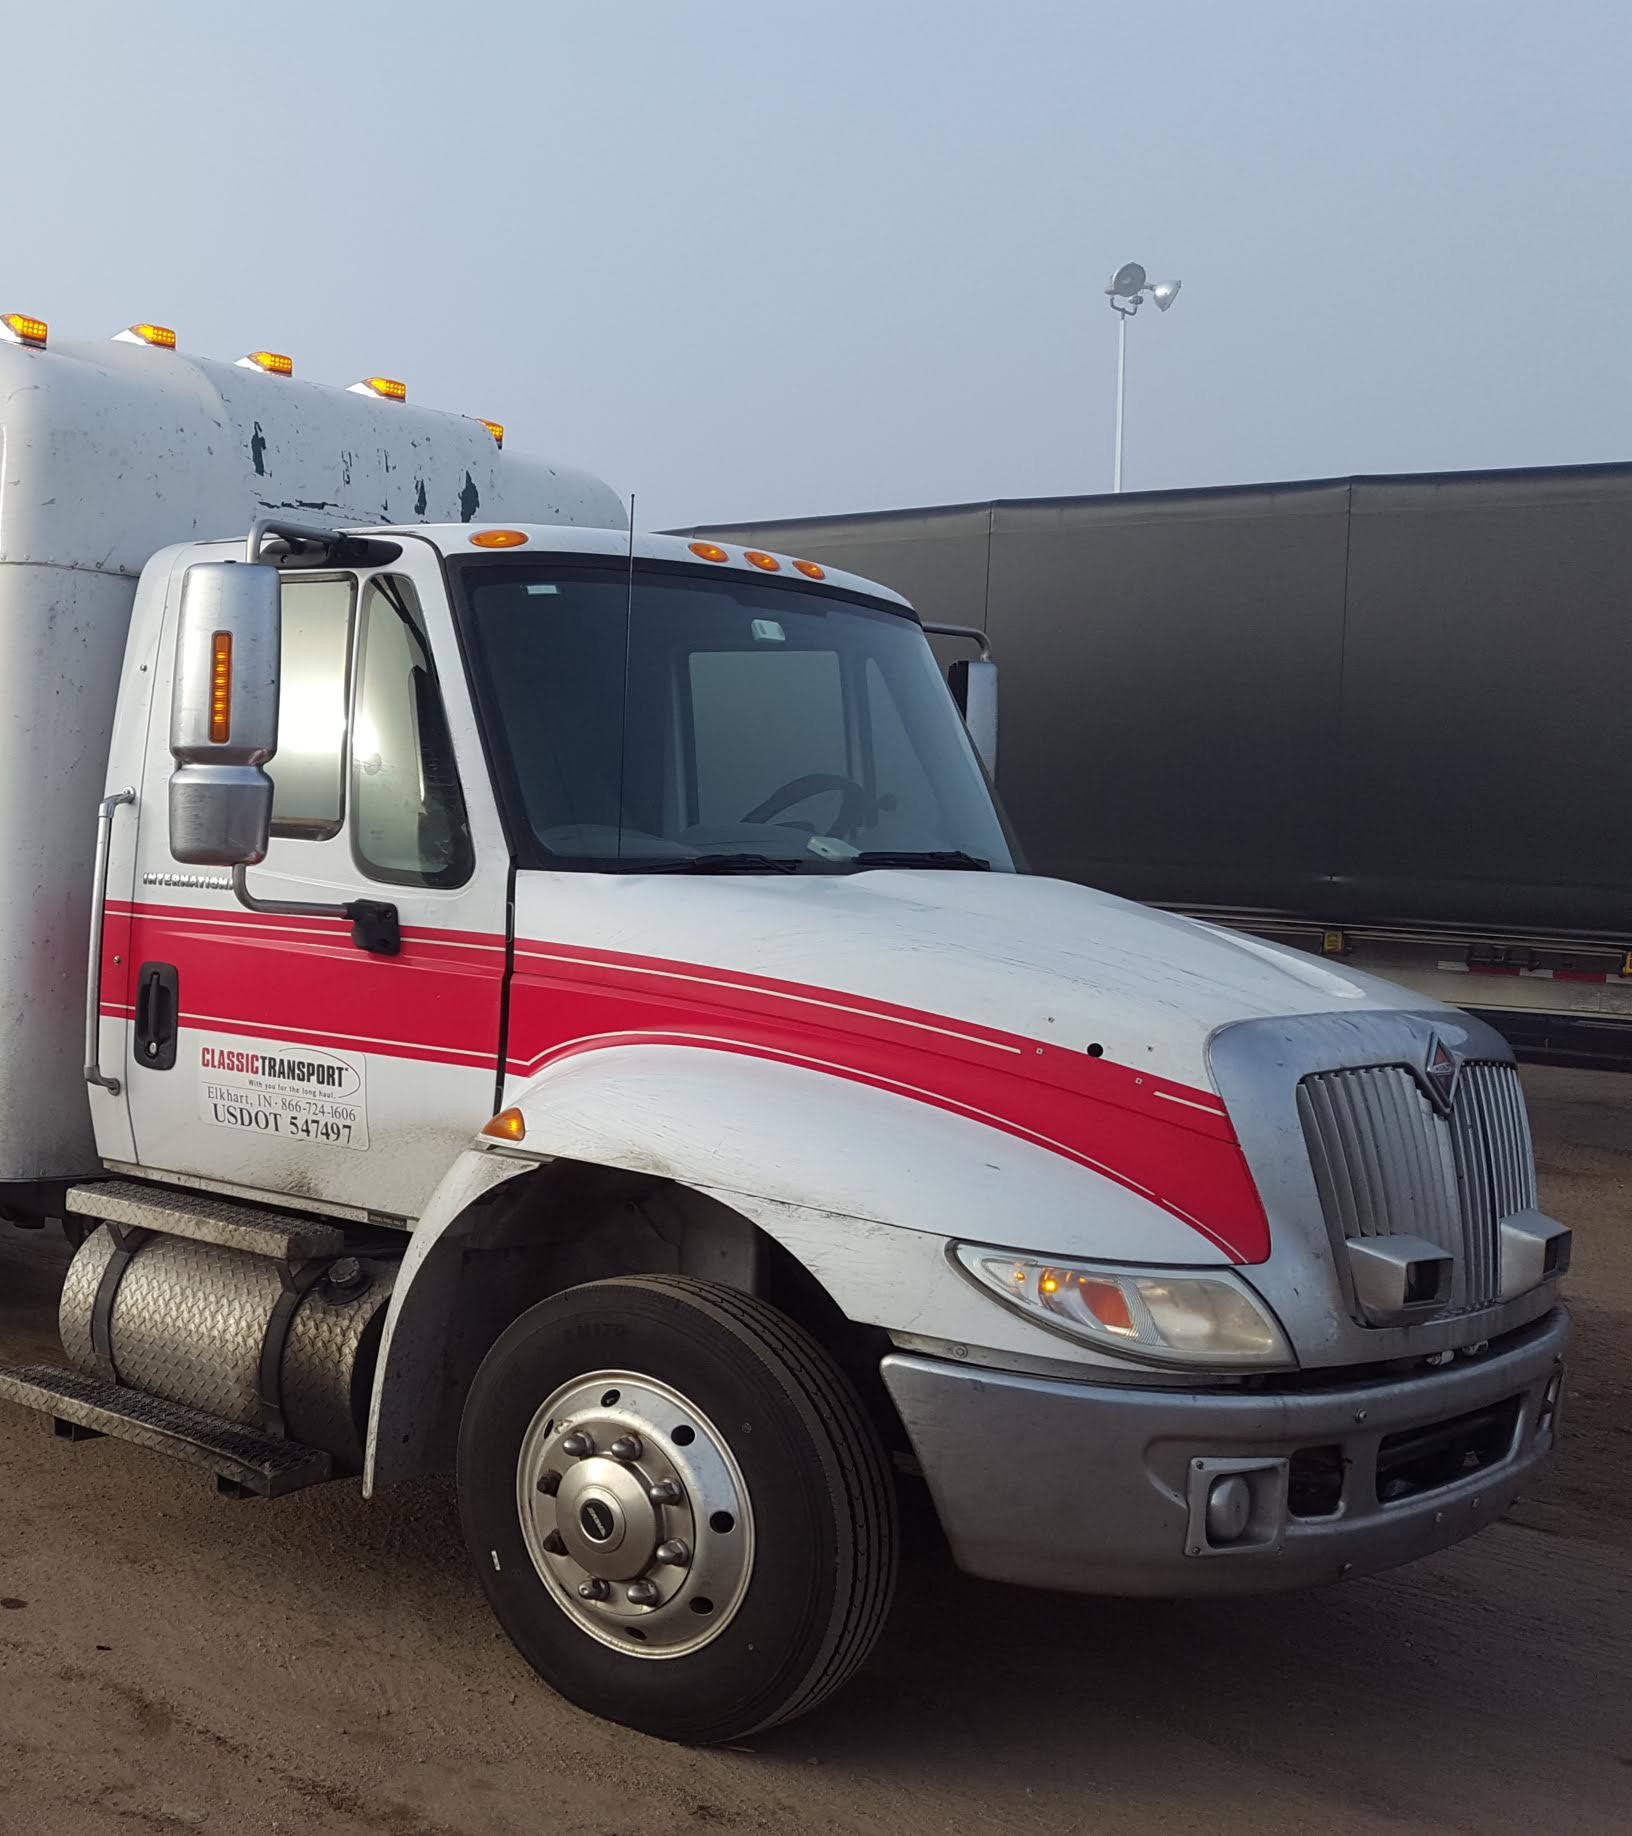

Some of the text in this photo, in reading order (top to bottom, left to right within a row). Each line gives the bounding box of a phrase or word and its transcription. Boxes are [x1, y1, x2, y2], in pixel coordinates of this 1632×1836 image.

[208, 1086, 253, 1107] Elkhart,
[281, 1098, 355, 1121] 866-724-1606
[248, 1080, 262, 1088] With
[289, 1085, 299, 1093] the
[302, 1088, 316, 1097] long
[319, 1090, 336, 1099] haul.
[212, 1103, 352, 1144] USDOT 547497
